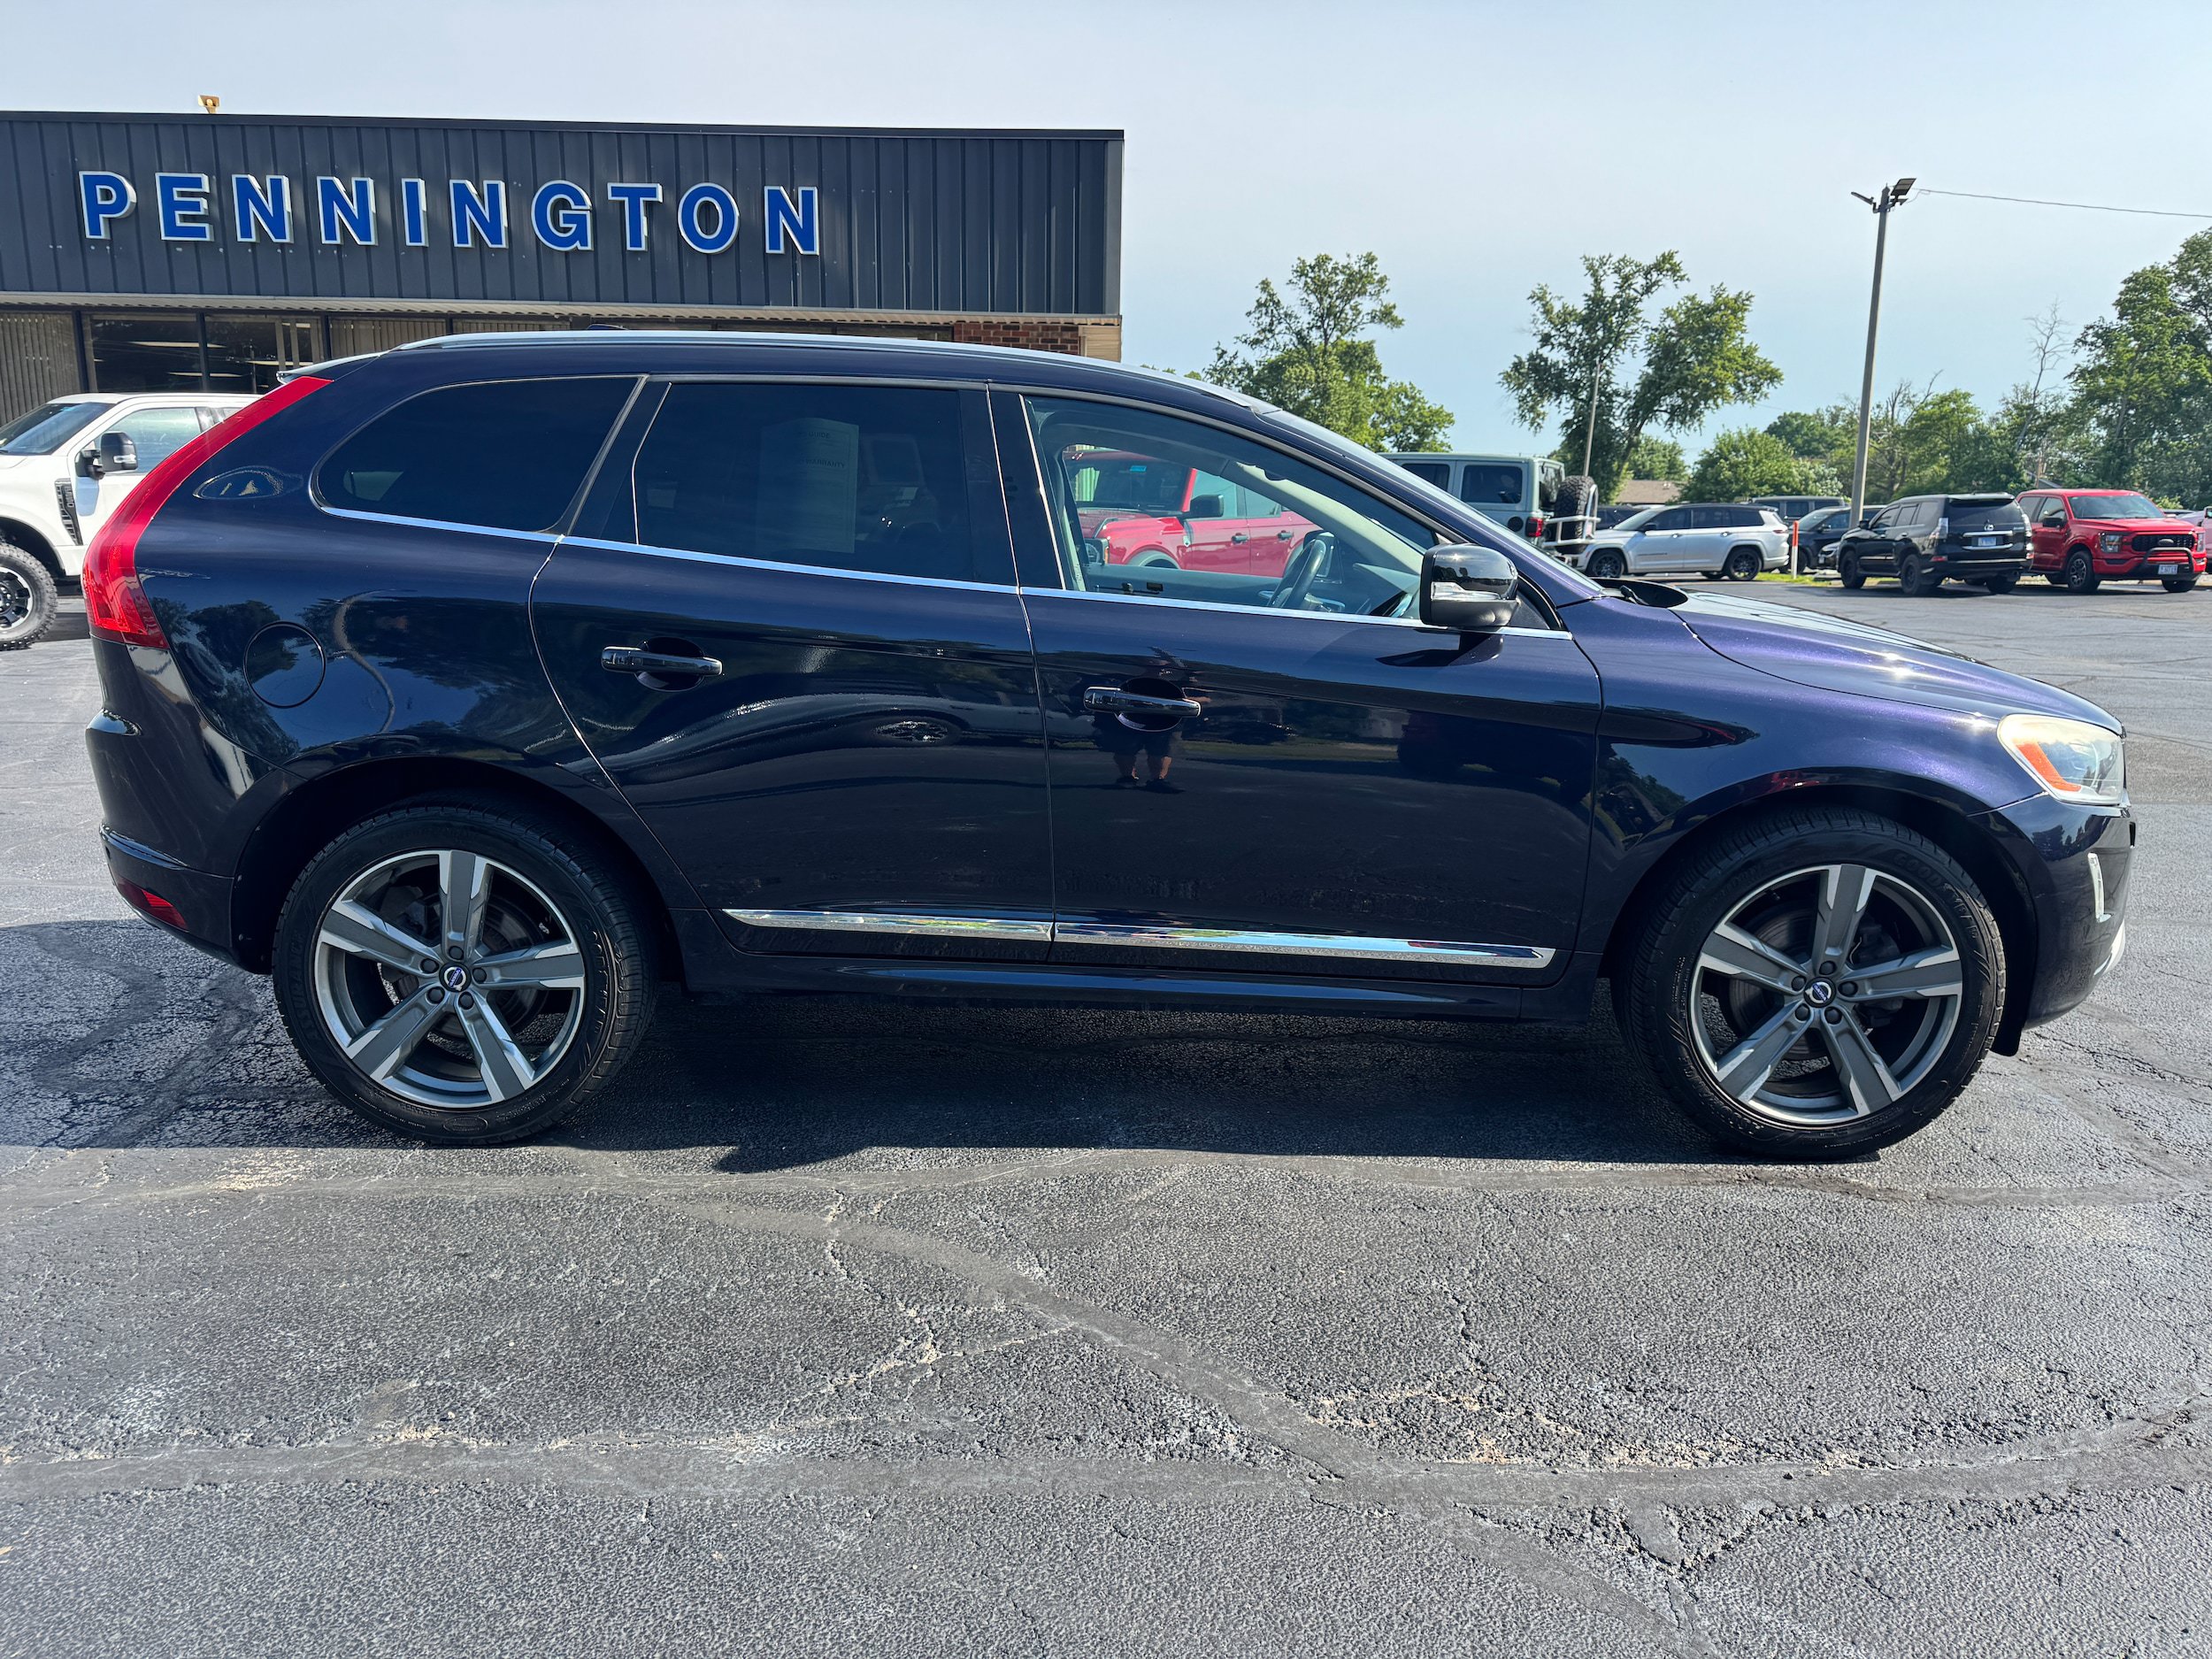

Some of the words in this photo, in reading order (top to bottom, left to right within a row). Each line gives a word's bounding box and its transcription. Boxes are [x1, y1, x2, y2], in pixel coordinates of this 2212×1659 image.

[79, 171, 819, 256] PENNINGTON
[808, 431, 830, 440] GUIDE
[806, 458, 845, 469] WARRANTY
